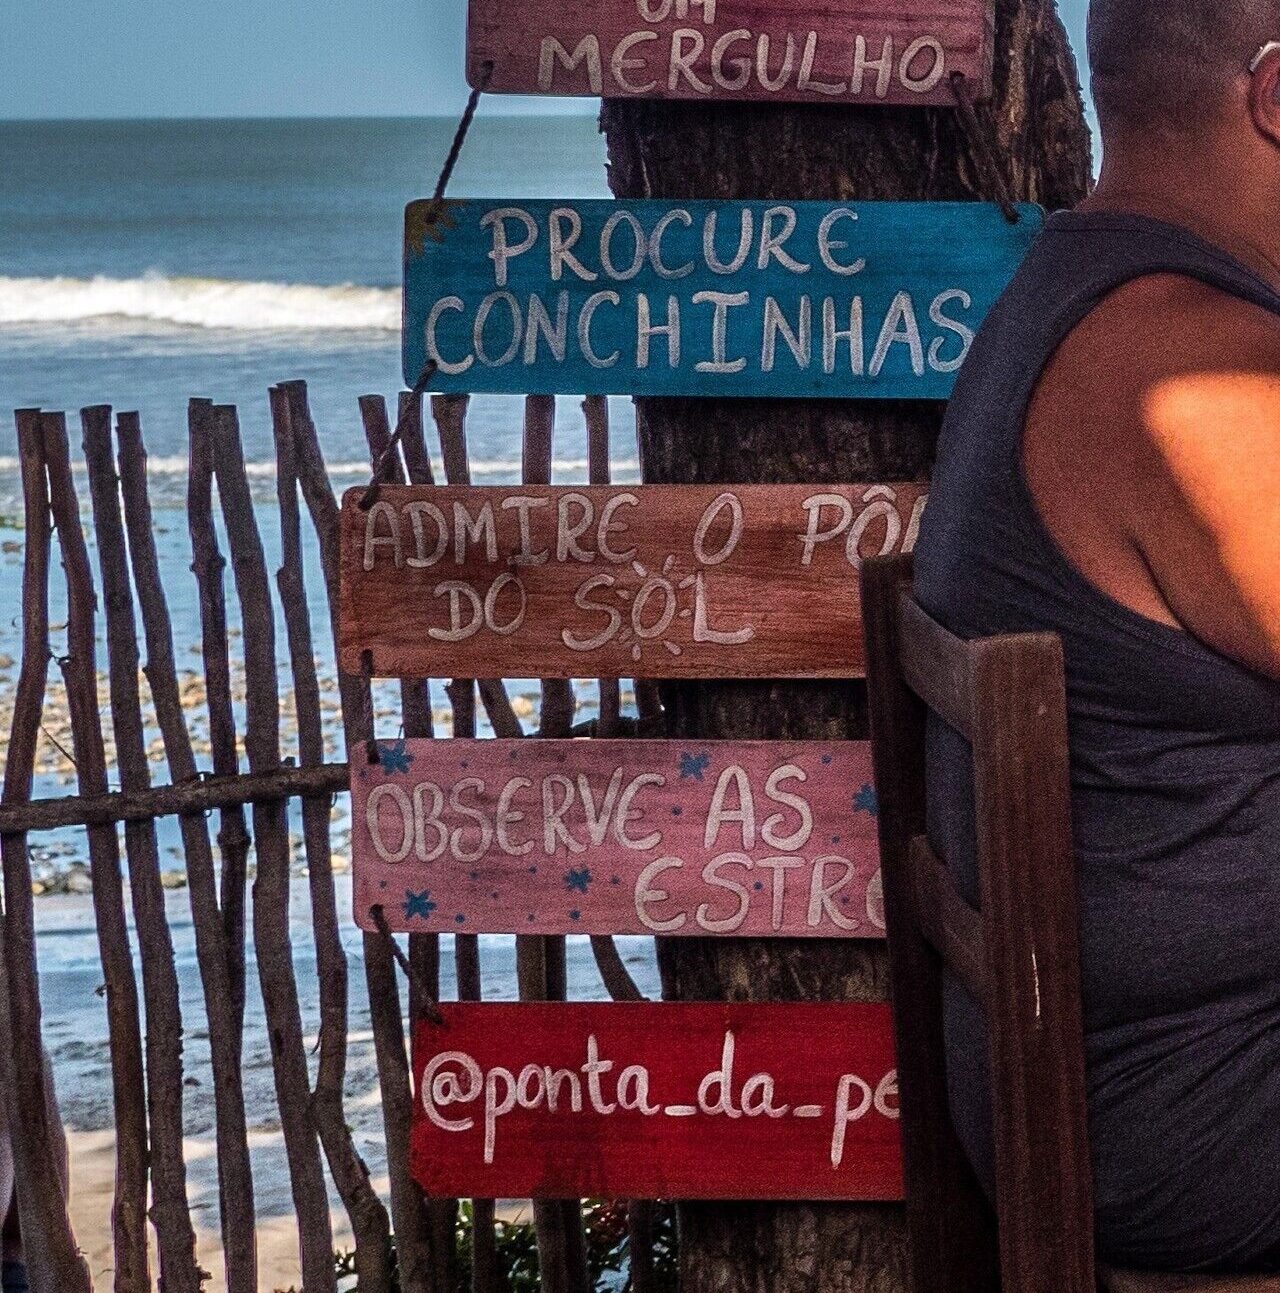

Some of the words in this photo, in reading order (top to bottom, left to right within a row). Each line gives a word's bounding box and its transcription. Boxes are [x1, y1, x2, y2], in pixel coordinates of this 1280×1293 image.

[536, 28, 945, 95] MERGULHO
[479, 206, 866, 286] PROCURE
[425, 288, 975, 375] CONCHINHAS
[363, 494, 641, 572] ADMIRE
[692, 492, 745, 566] O
[428, 572, 529, 642] DO
[562, 570, 755, 651] SOL
[365, 765, 665, 864] OBSERVE
[702, 763, 813, 850] AS
